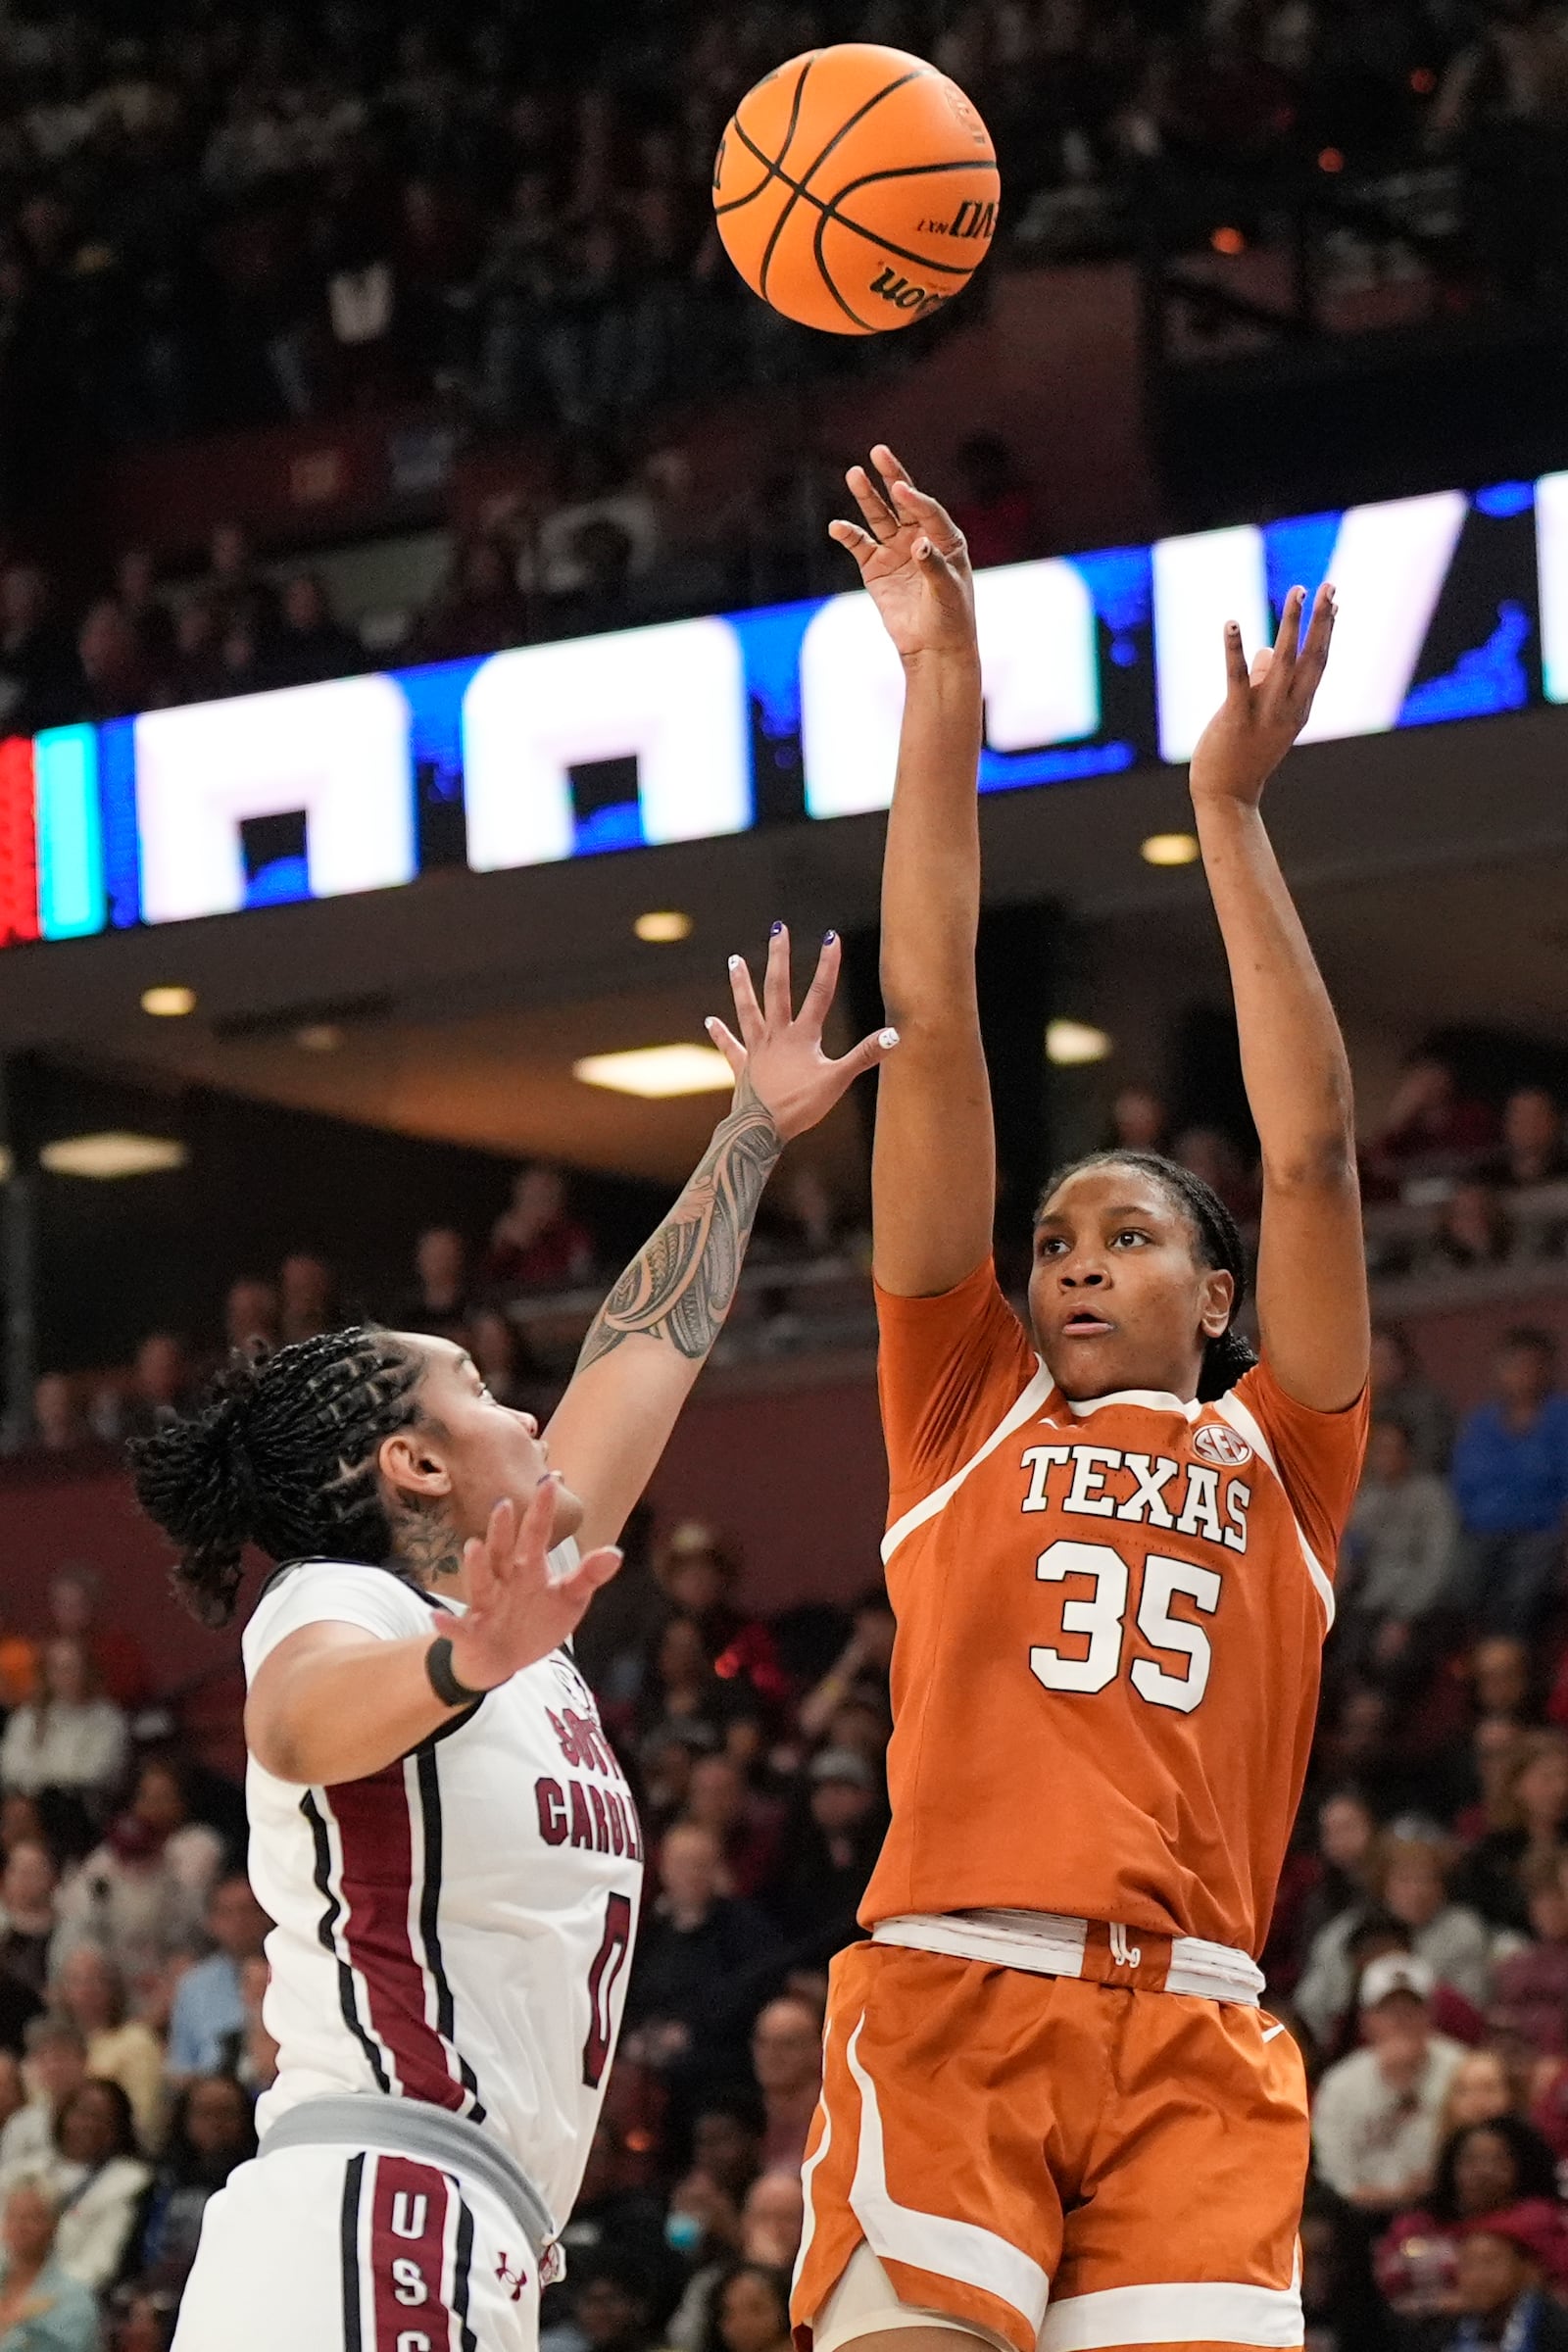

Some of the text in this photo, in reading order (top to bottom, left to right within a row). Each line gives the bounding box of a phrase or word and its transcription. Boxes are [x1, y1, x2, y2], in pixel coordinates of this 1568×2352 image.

[1020, 1444, 1250, 1554] TEXAS
[1196, 1428, 1250, 1462] SEC
[1029, 1540, 1223, 1713] 35
[582, 1891, 631, 2089] 0
